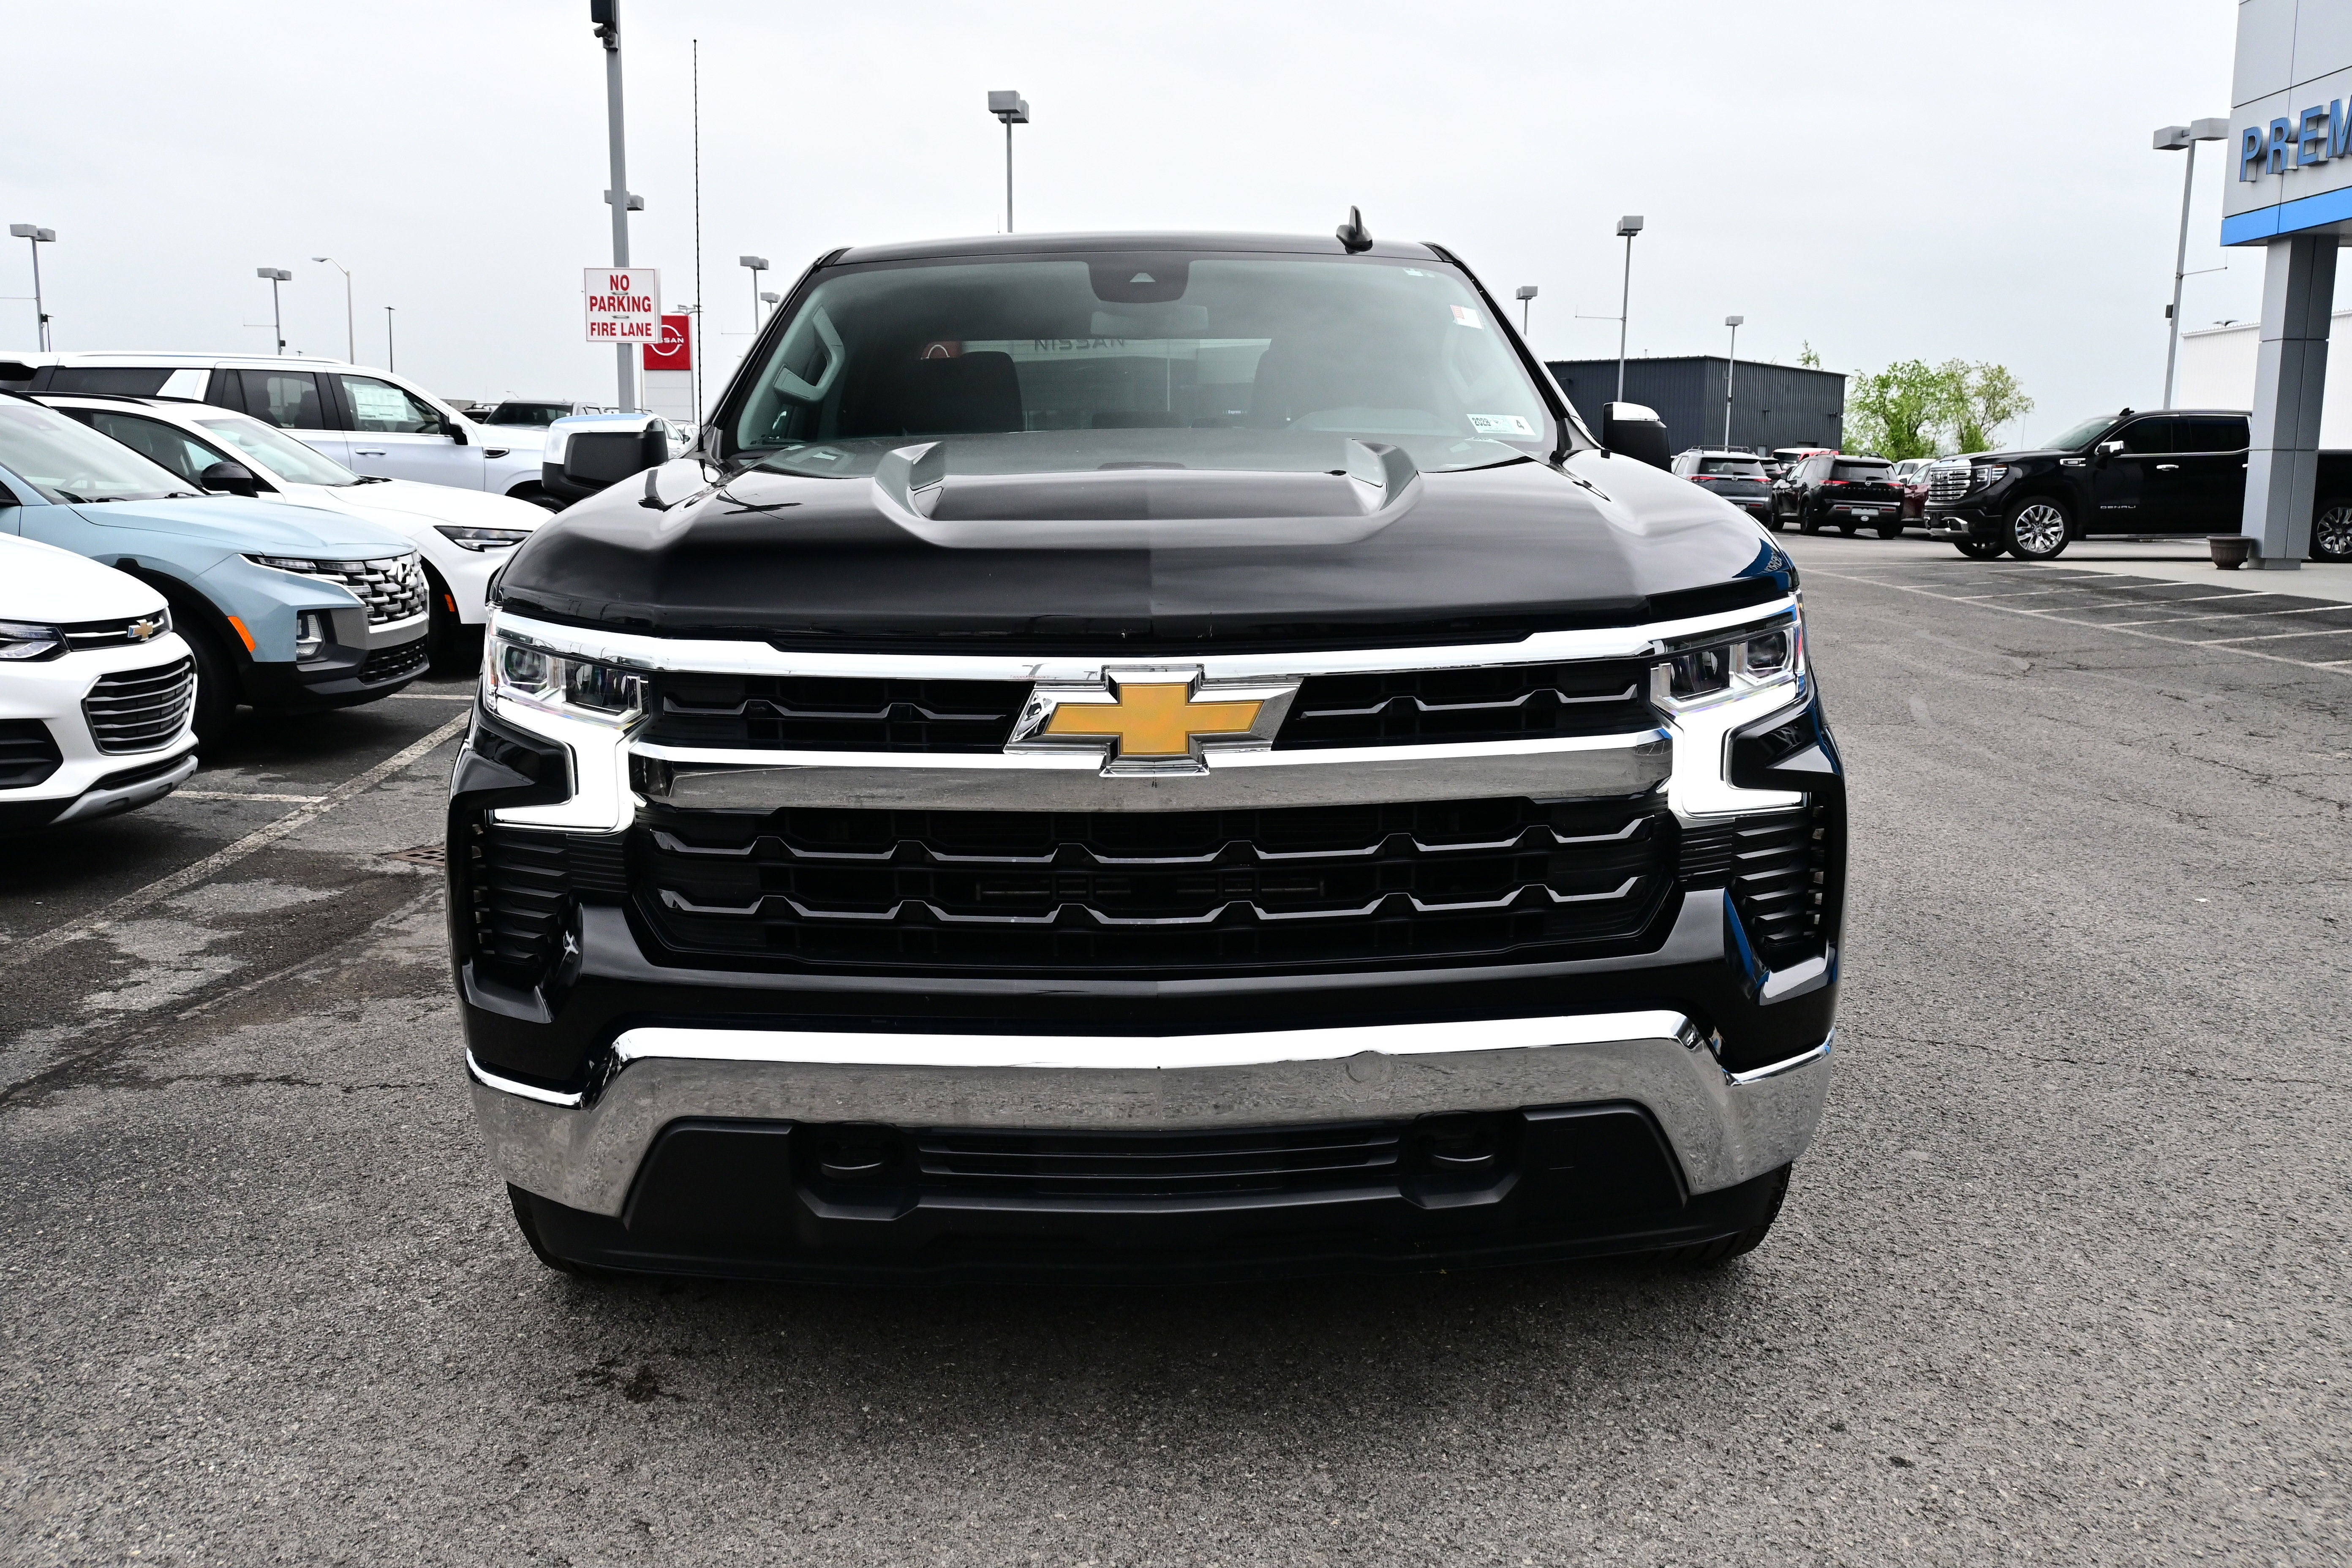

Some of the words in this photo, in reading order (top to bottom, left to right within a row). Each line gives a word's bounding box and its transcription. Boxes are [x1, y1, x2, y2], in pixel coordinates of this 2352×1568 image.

[610, 274, 629, 291] NO
[589, 296, 651, 313] PARKING
[590, 322, 616, 336] FIRE
[621, 322, 652, 337] LANE
